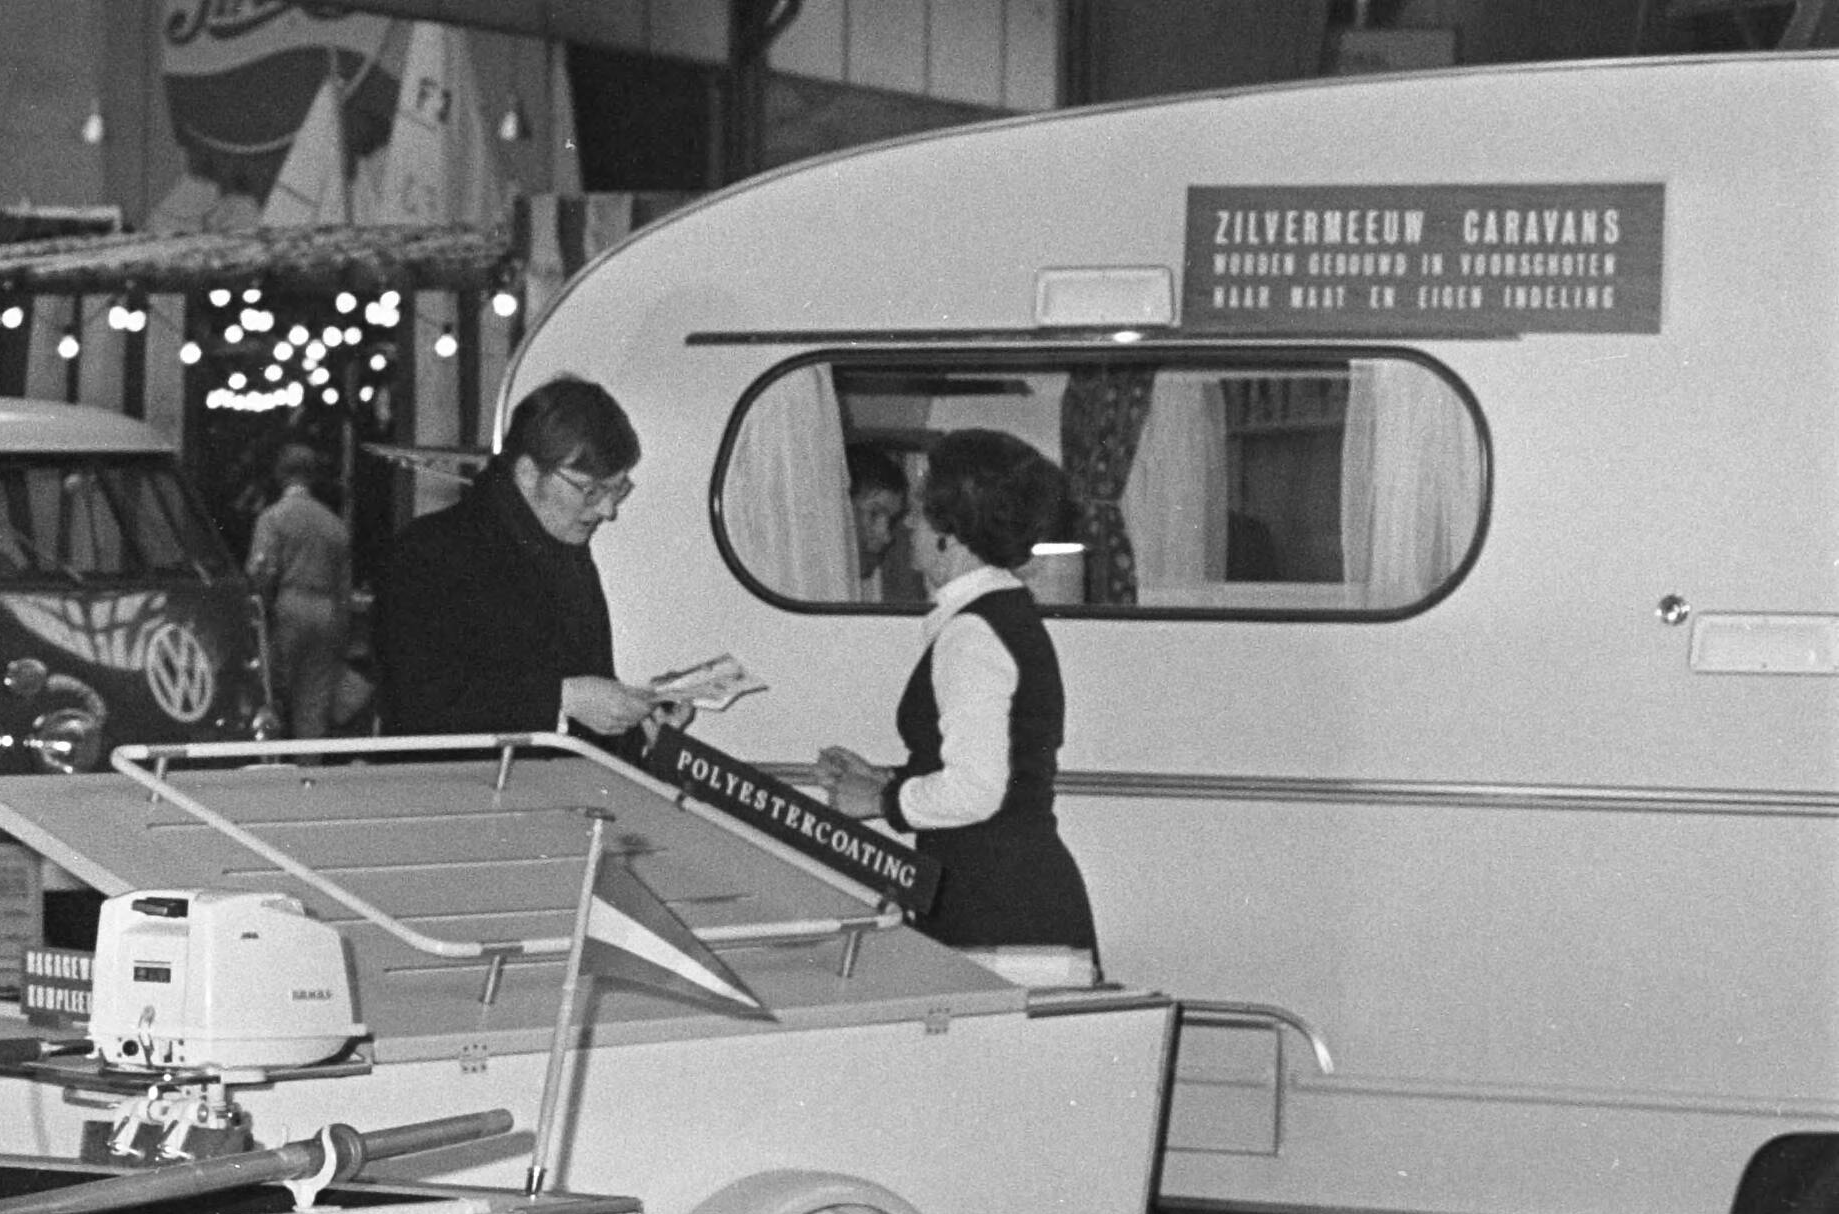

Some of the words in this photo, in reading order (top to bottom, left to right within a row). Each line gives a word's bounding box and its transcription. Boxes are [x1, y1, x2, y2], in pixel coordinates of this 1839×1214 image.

[1214, 211, 1424, 244] ZILVERMEEUW
[1465, 210, 1620, 244] CARAVANS
[1213, 253, 1295, 276] WORDEN
[1308, 253, 1407, 276] GEBOUWD
[1421, 253, 1444, 276] IN
[1462, 253, 1614, 276] VOORSCHOTEN
[1214, 285, 1269, 309] NAAR
[1291, 285, 1345, 309] MAAT
[1370, 285, 1395, 309] EN
[1418, 285, 1483, 309] EIGEN
[1504, 285, 1613, 309] INDELING
[677, 750, 917, 889] POLYESTERCOATING
[27, 951, 94, 981] BAGAGEW
